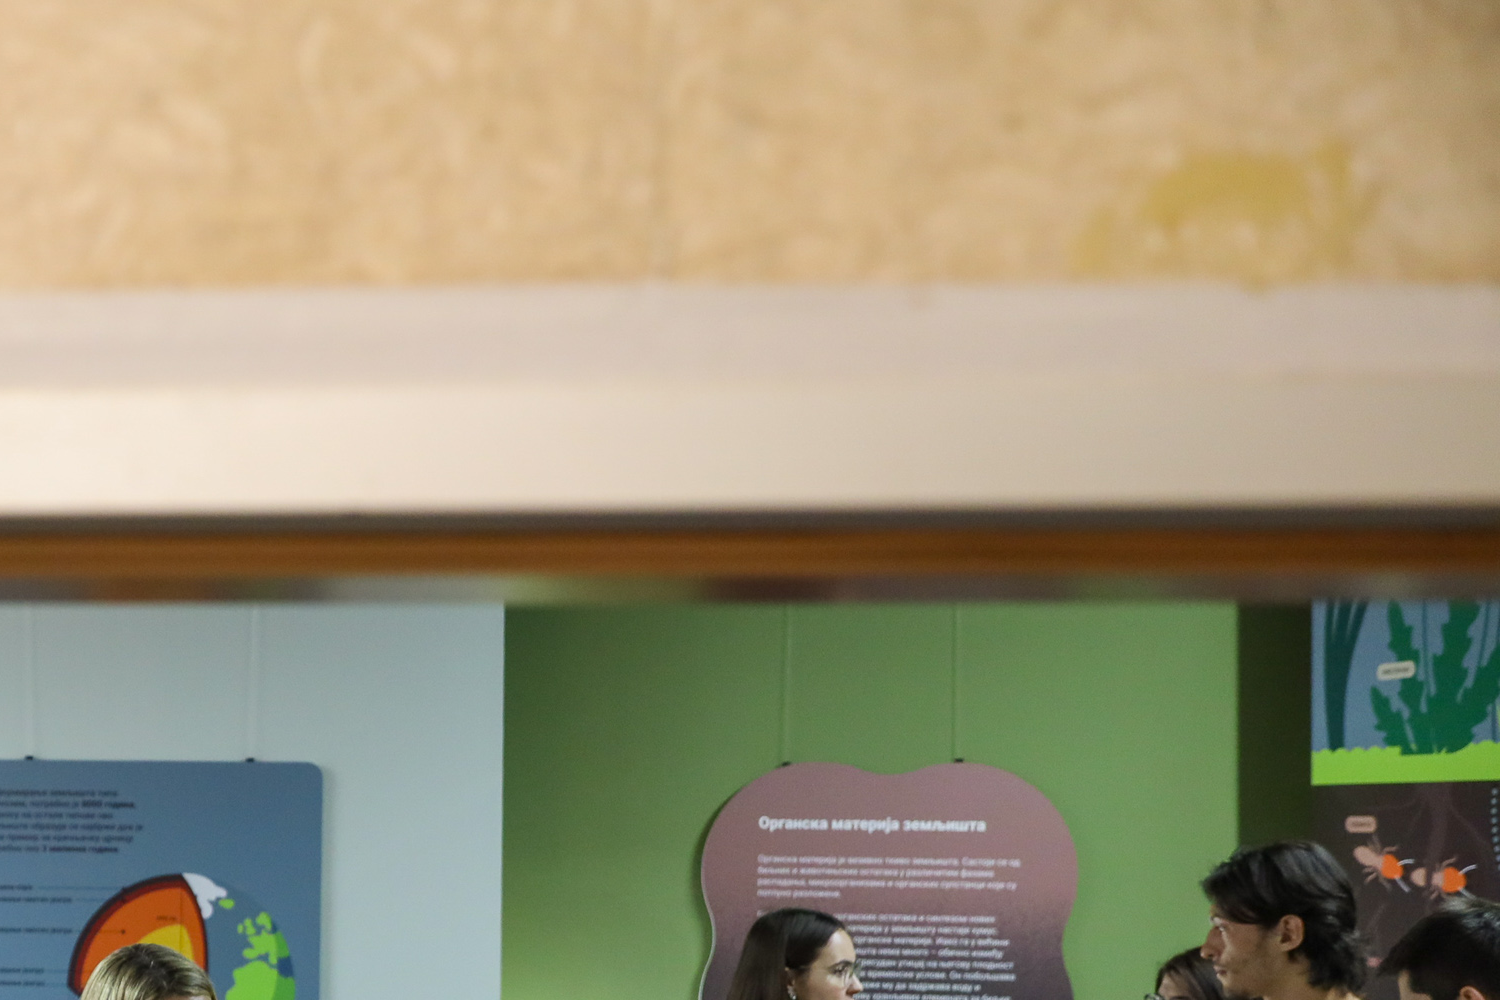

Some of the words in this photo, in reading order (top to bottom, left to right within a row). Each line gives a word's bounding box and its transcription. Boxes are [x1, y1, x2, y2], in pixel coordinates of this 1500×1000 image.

[758, 816, 828, 833] Органска
[831, 817, 900, 834] материја
[903, 819, 987, 833] земљишта
